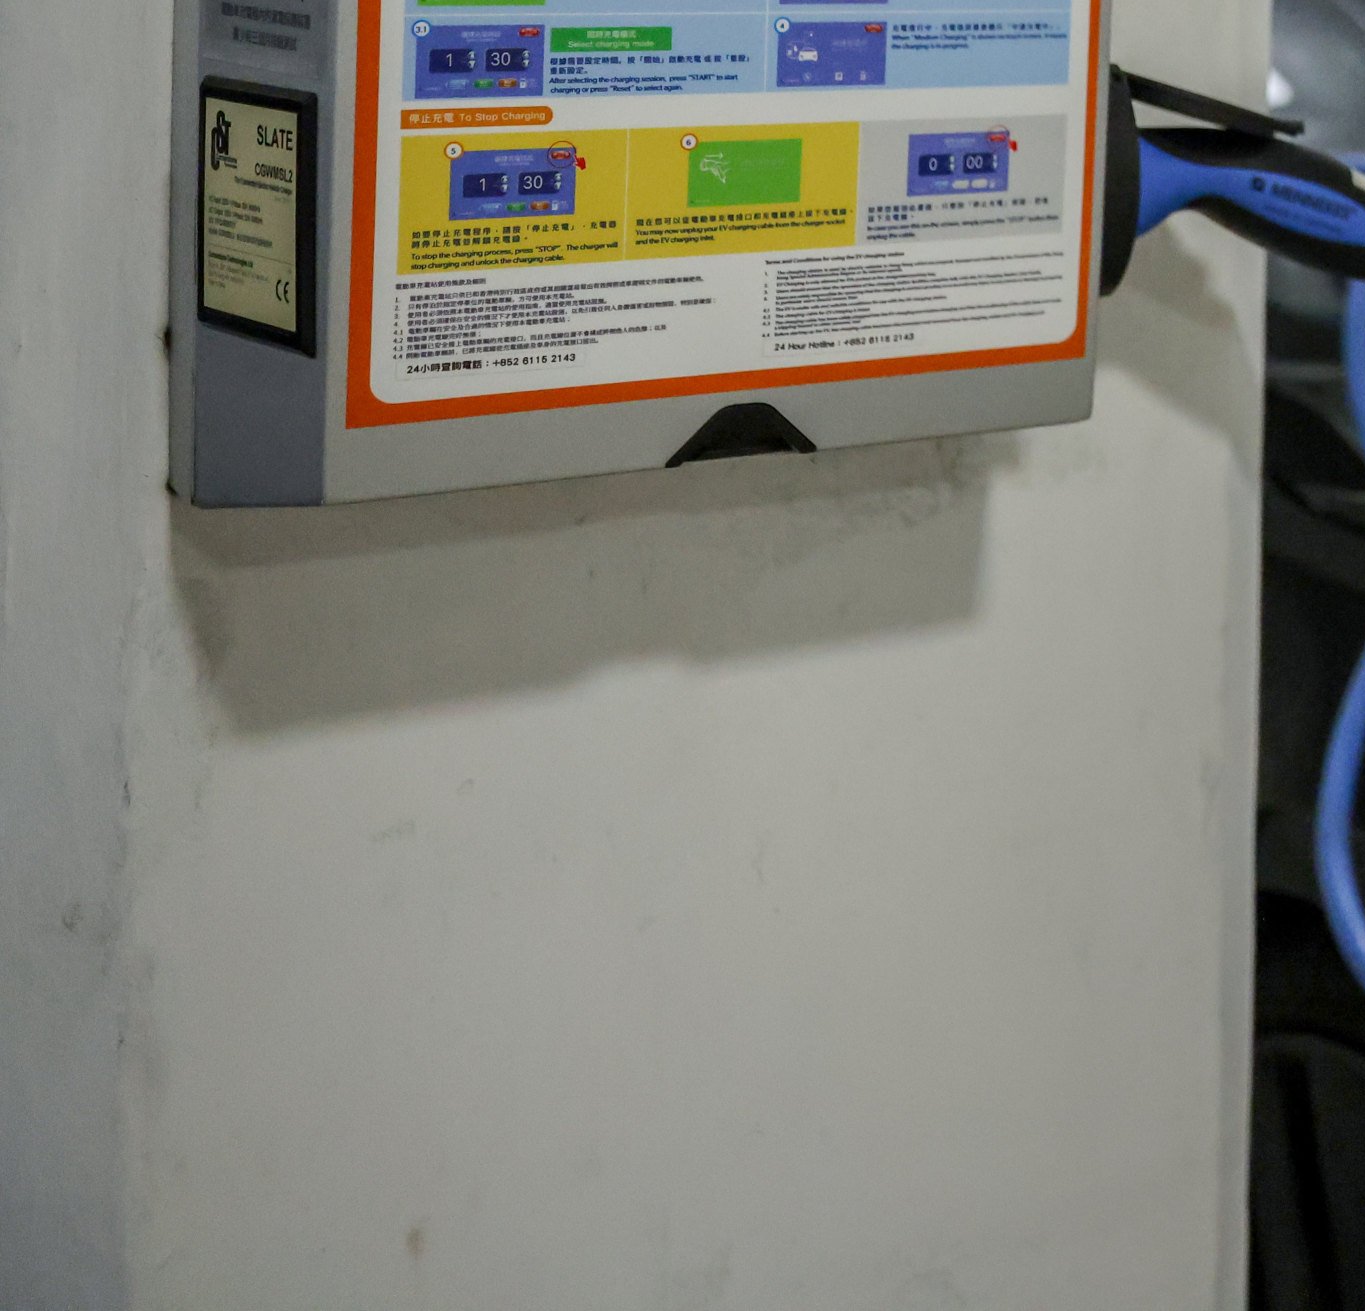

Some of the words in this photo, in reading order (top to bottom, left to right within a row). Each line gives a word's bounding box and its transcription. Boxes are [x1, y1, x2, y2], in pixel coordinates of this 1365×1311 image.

[415, 26, 427, 34] 3.1
[568, 40, 593, 49] Select
[595, 40, 630, 49] charging
[632, 40, 654, 48] mode
[446, 53, 452, 67] 1
[490, 52, 511, 67] 30
[549, 76, 566, 85] After
[568, 76, 598, 86] selecting
[599, 76, 610, 84] the
[611, 75, 640, 85] charging
[642, 75, 667, 84] session,
[669, 74, 687, 84] press
[689, 74, 715, 83] "START"
[550, 86, 580, 95] charging
[590, 85, 608, 94] press
[610, 85, 634, 94] "Reset"
[635, 84, 643, 92] to
[644, 84, 662, 92] select
[664, 84, 683, 93] again.
[409, 112, 455, 124] 停止充電
[459, 113, 471, 122] To
[475, 113, 498, 122] Stop
[502, 112, 546, 121] Charging
[256, 124, 293, 151] SLATE
[451, 147, 456, 155] 5
[929, 158, 938, 171] 0
[966, 156, 983, 169] 00
[254, 162, 293, 183] CGWMSL2
[479, 178, 487, 192] 1
[523, 175, 543, 190] 30
[412, 252, 420, 260] To
[421, 251, 437, 262] stop
[439, 250, 451, 259] the
[452, 248, 483, 260] charging
[484, 247, 513, 258] process,
[515, 246, 533, 256] press
[535, 244, 561, 255] "STOP"
[566, 243, 579, 252] The
[580, 242, 605, 253] charger
[606, 241, 619, 249] will
[411, 261, 427, 271] stop
[428, 260, 459, 270] charging
[460, 259, 474, 267] and
[475, 258, 499, 266] unlock
[500, 257, 512, 265] the
[512, 256, 543, 266] charging
[545, 255, 565, 263] cable.
[276, 279, 289, 304] CE
[774, 343, 785, 351] 24
[788, 342, 806, 350] Hour
[808, 340, 835, 349] Hotline
[893, 333, 914, 342] 2143
[522, 355, 547, 364] 6115
[551, 353, 576, 363] 2143
